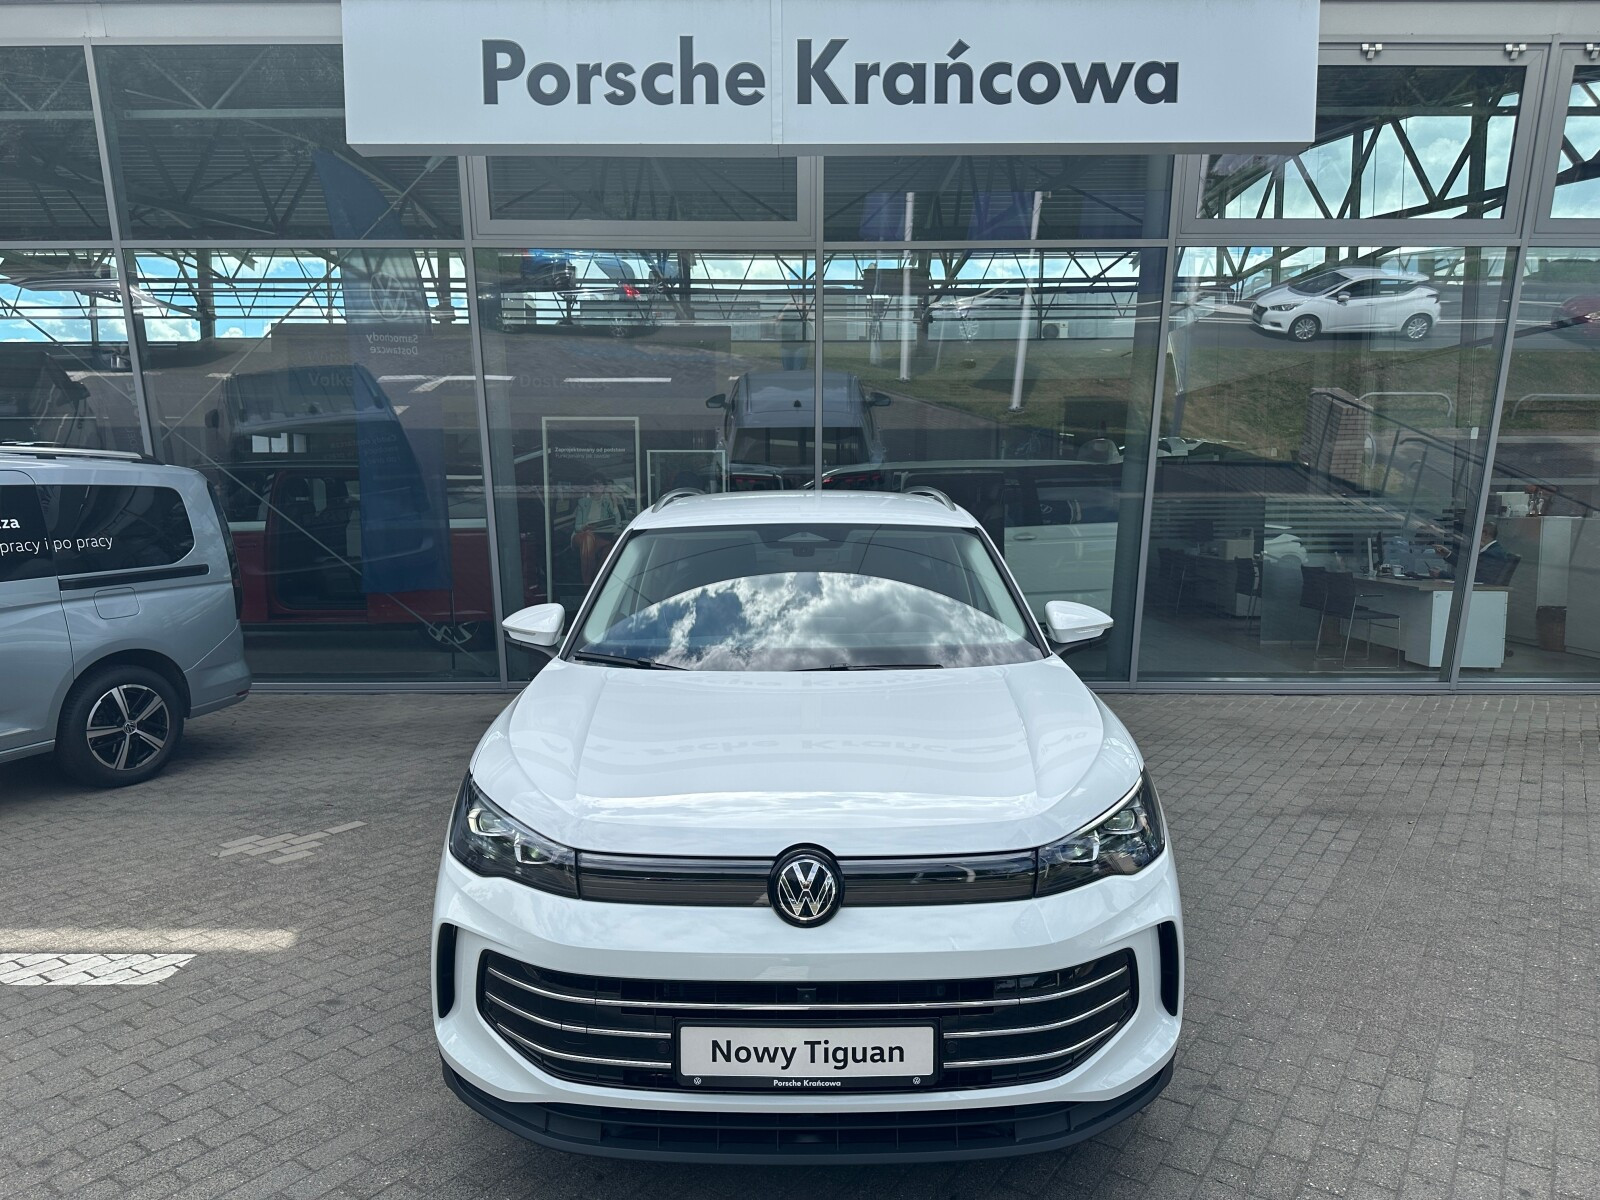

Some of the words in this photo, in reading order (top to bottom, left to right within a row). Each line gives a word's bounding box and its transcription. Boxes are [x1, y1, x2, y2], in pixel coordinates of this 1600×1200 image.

[481, 36, 766, 106] Porsche
[796, 38, 1180, 105] Krańcowa
[0, 518, 20, 529] za
[0, 541, 40, 556] pracy
[44, 537, 49, 550] i
[53, 539, 72, 552] po
[76, 537, 113, 552] pracy
[711, 1040, 797, 1070] Nowy
[804, 1039, 905, 1070] Tiguan
[773, 1079, 801, 1087] Porsche
[803, 1079, 842, 1087] Krańcowa
